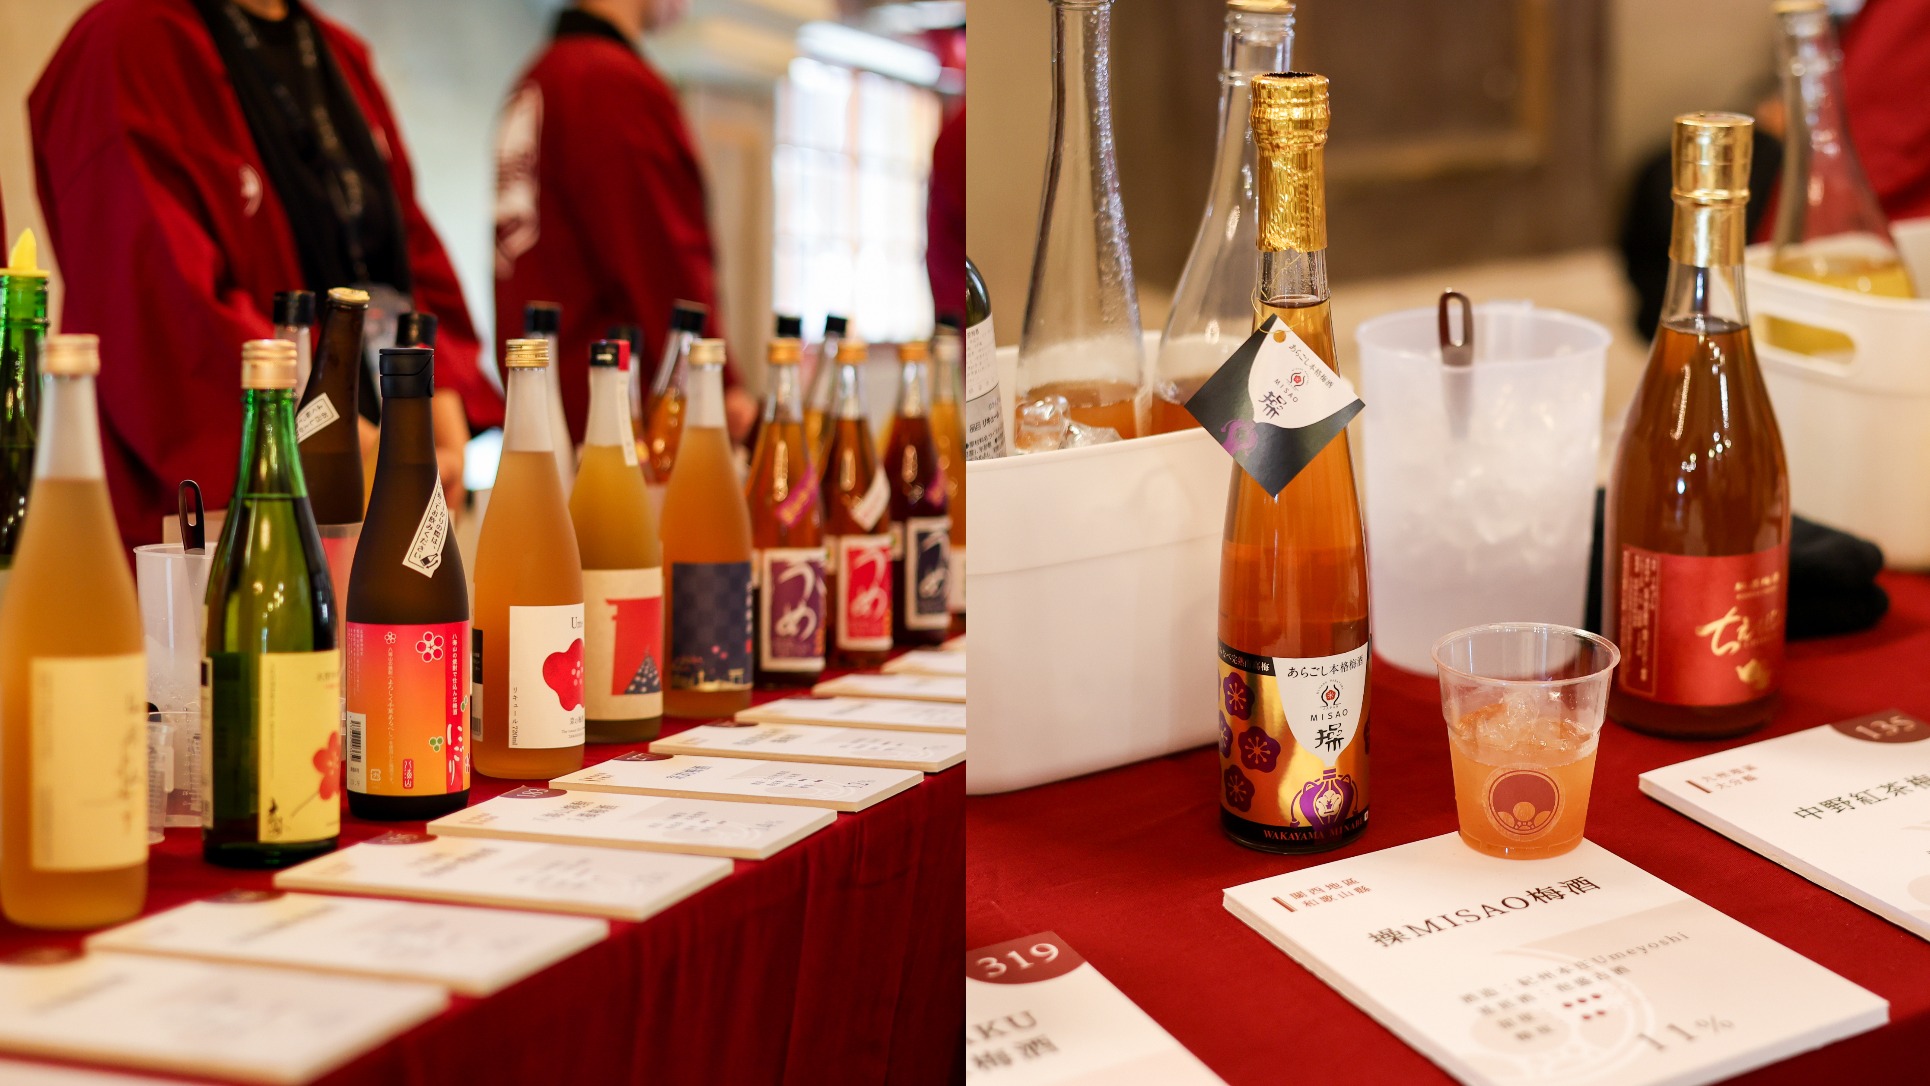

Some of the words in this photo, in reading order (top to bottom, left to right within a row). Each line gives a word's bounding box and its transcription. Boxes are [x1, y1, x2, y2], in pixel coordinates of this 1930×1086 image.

[1274, 378, 1299, 403] MISAO
[1287, 655, 1364, 679] あらごし本格梅酒
[1310, 709, 1349, 722] MISAO
[1855, 715, 1916, 739] 135
[1263, 829, 1325, 841] WAKAYAMA
[976, 942, 1060, 979] 319
